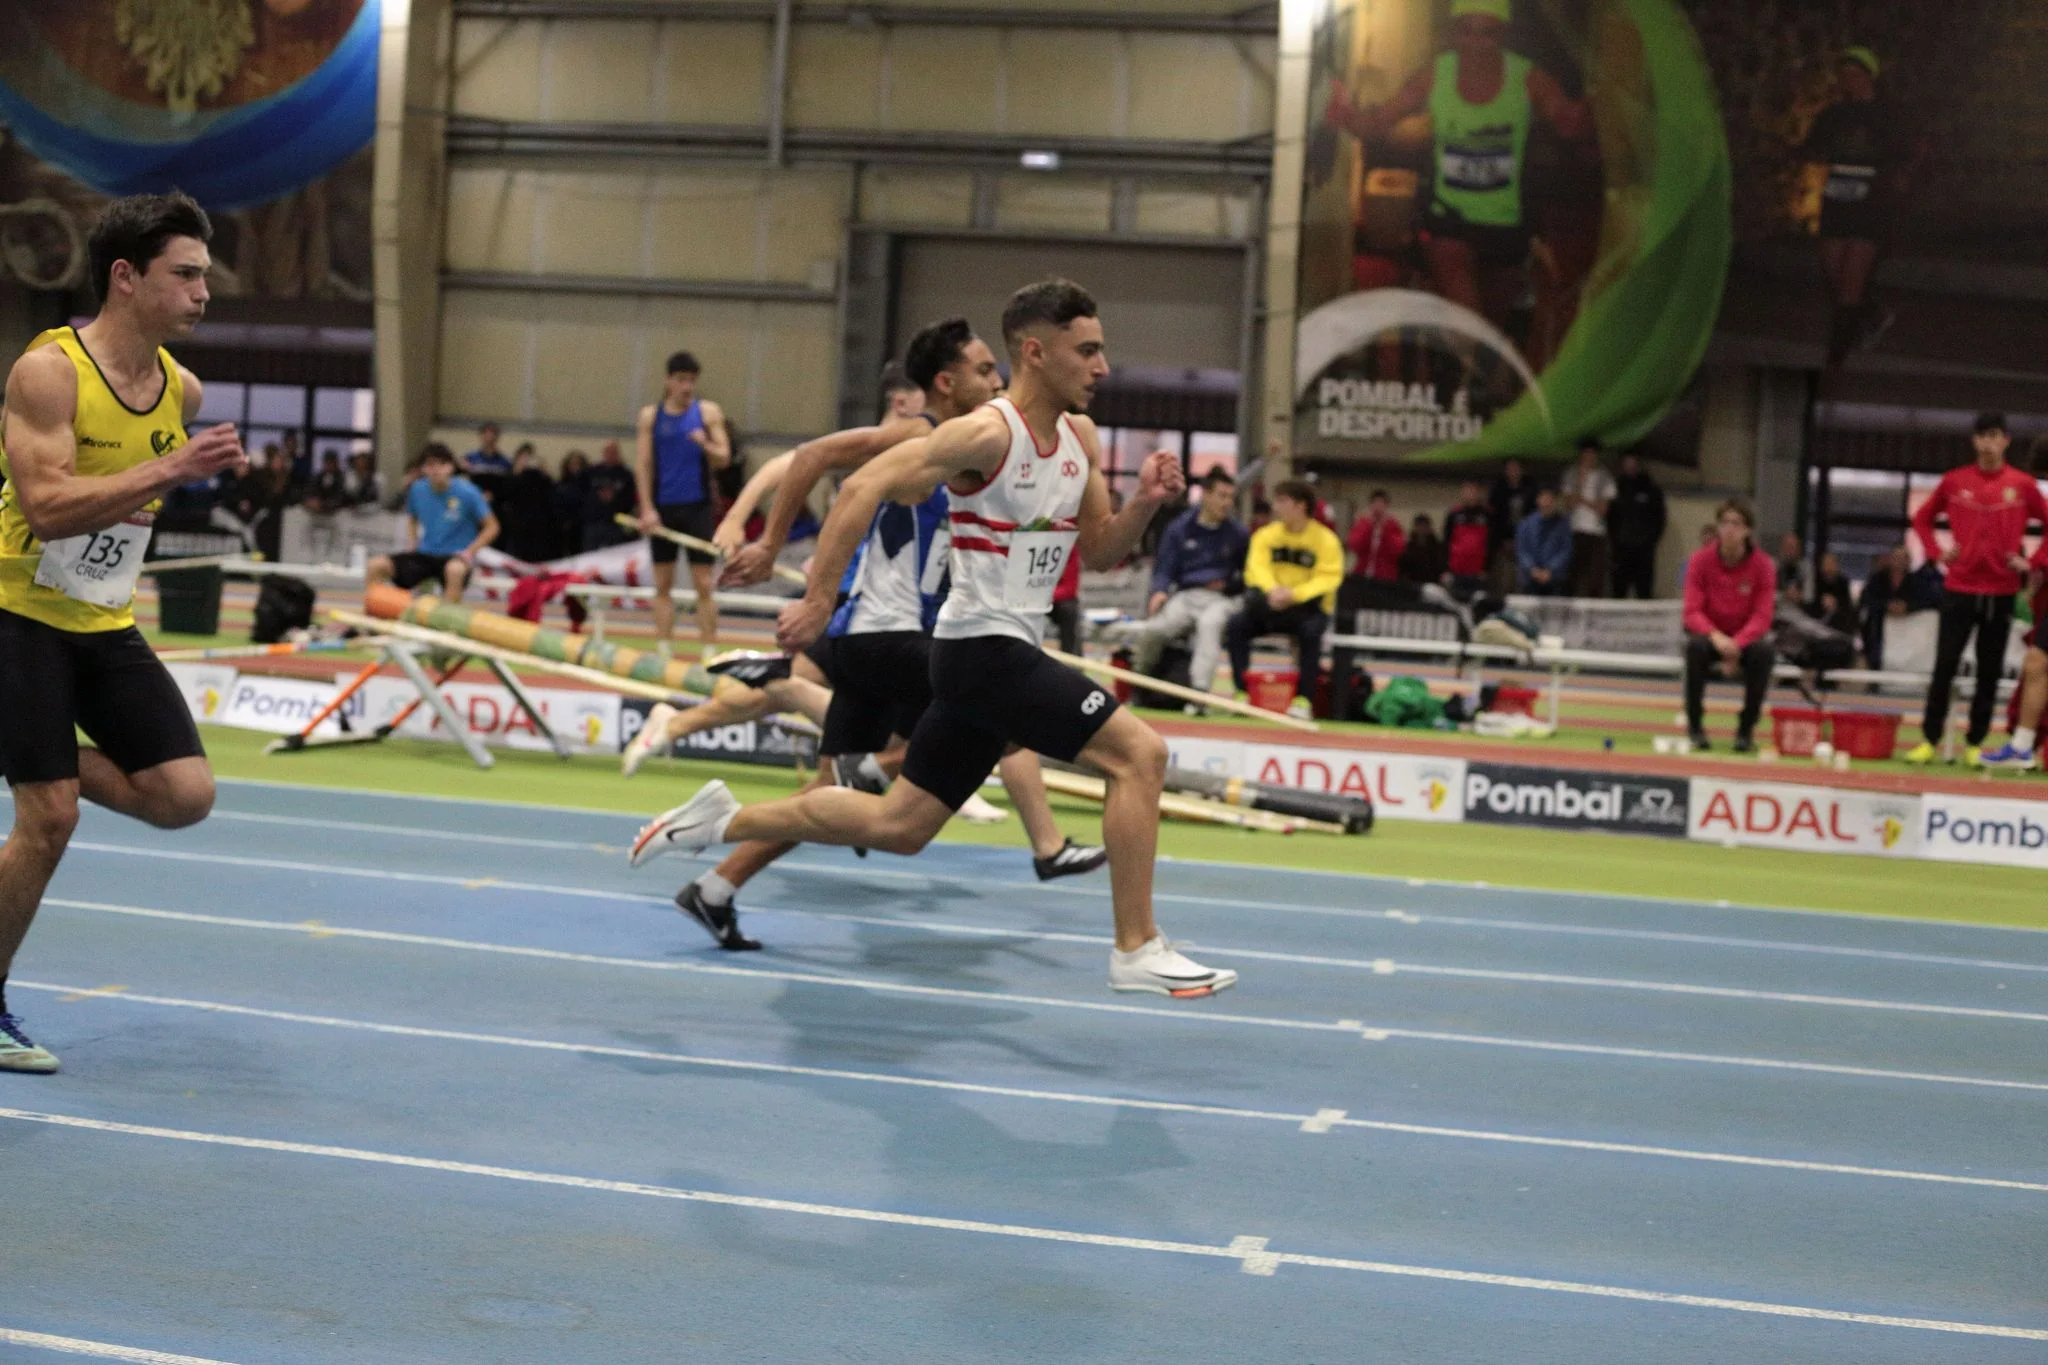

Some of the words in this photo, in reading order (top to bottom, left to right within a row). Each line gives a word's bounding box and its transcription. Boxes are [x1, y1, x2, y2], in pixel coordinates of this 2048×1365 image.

[1320, 379, 1444, 411] POMBAL
[1319, 408, 1482, 441] DESPORTO!
[81, 532, 130, 568] 135
[1027, 546, 1062, 574] 149
[75, 563, 108, 581] CRUZ
[1258, 757, 1406, 805] ADAL
[1465, 773, 1623, 821] Pombal
[1700, 789, 1857, 843] ADAL
[1926, 808, 2048, 849] Pomb
